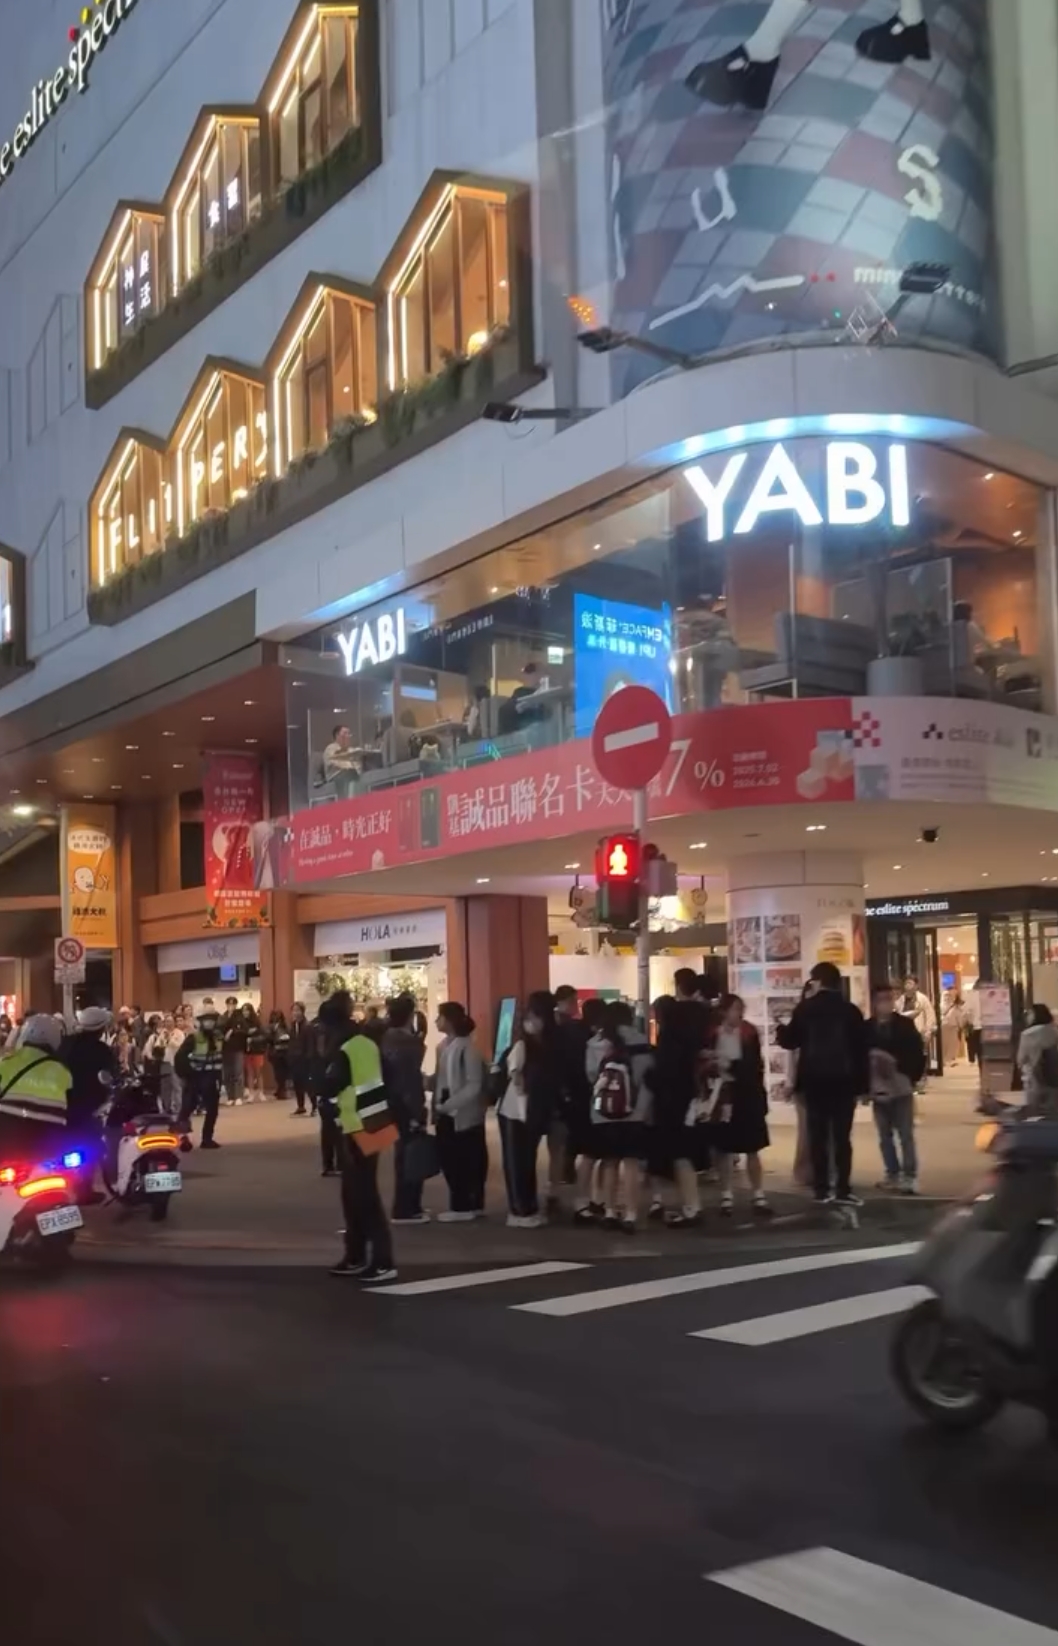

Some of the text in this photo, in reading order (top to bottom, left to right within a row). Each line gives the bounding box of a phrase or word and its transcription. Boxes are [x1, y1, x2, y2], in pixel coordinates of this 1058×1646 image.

[13, 66, 65, 157] eslite
[67, 0, 139, 92] spec
[683, 441, 910, 543] YABI
[336, 607, 406, 677] YABI
[361, 924, 391, 942] HOLA
[876, 903, 902, 916] eslite
[902, 900, 949, 917] spectrum
